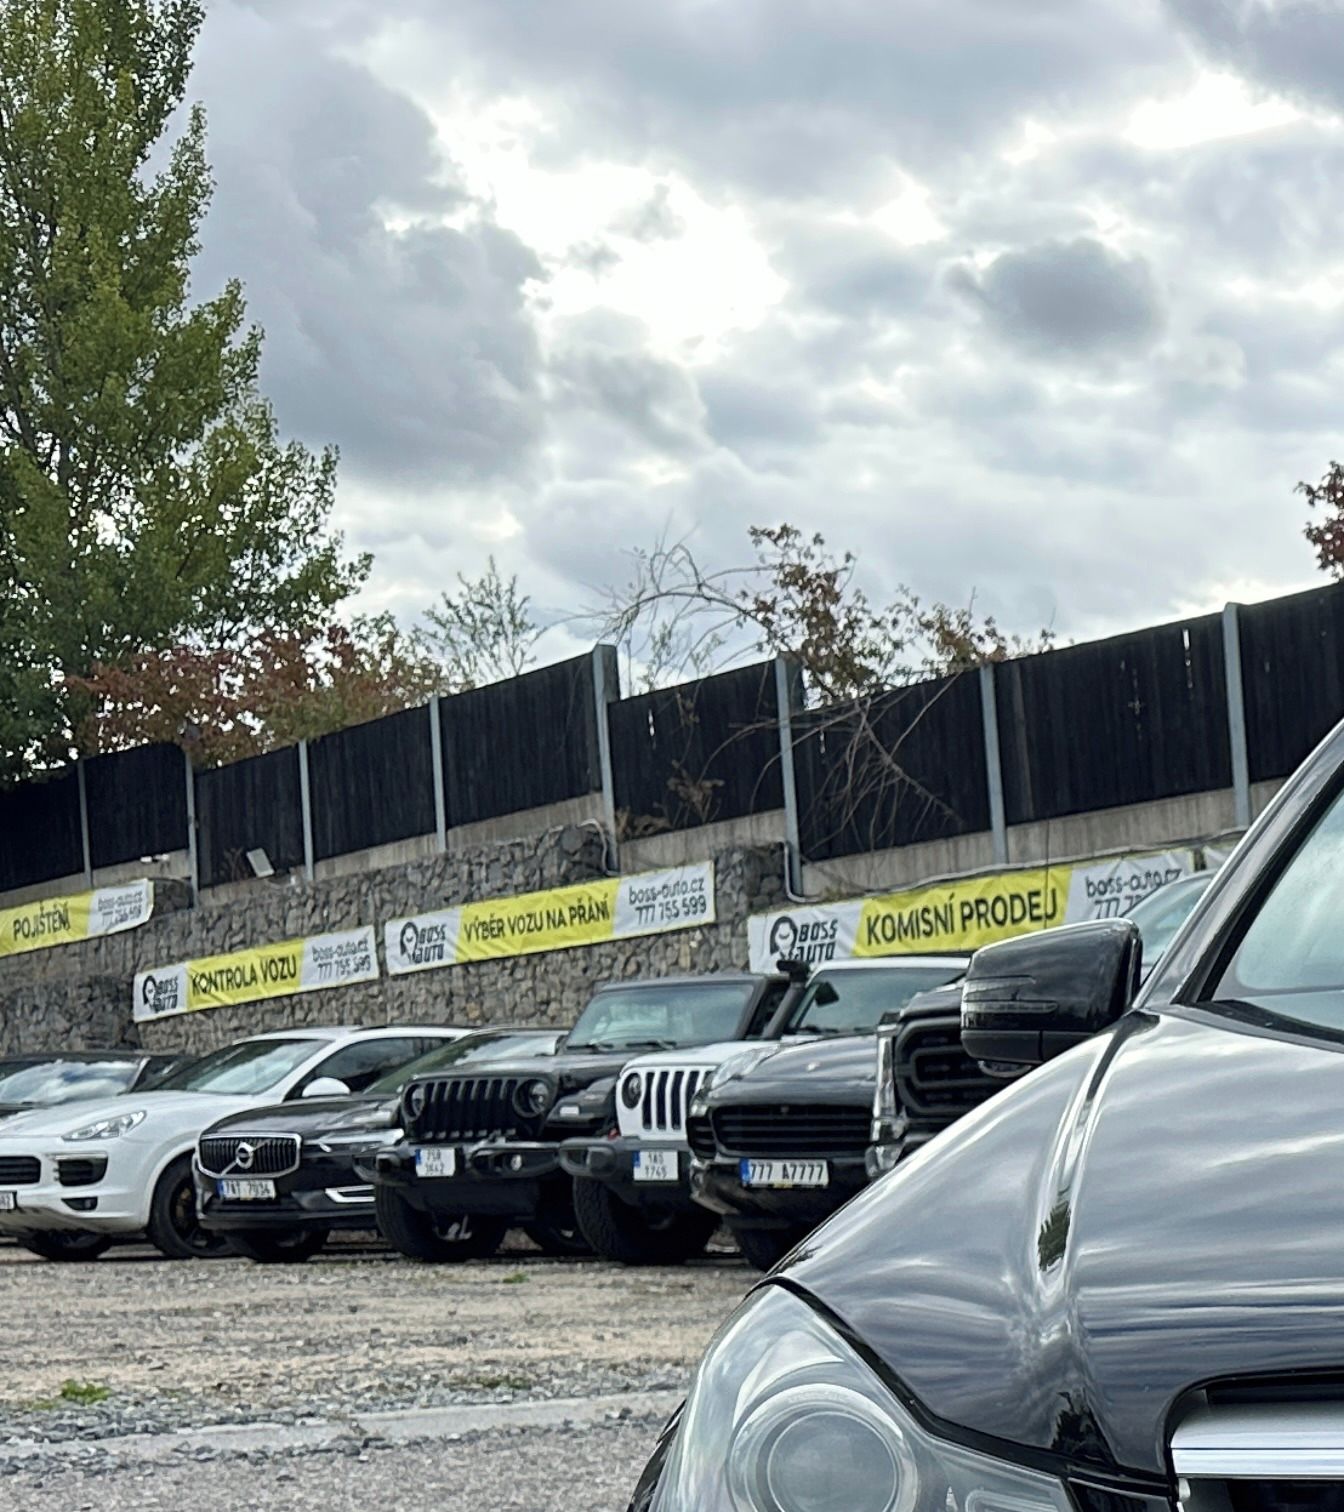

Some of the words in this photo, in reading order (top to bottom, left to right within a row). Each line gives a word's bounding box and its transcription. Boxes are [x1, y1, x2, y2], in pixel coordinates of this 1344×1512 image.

[627, 879, 705, 905] boss-auto.cz
[1085, 868, 1183, 898] boss-autocz
[464, 913, 506, 942] VÝBĚR
[507, 905, 543, 936] VOZU
[546, 904, 566, 930] NA
[568, 897, 610, 925] PŘÁNÍ
[866, 893, 955, 946] KOMISNÍ
[961, 887, 1057, 934] PRODEJ
[800, 920, 838, 942] BOSS
[796, 942, 836, 963] AUTO
[191, 962, 257, 996] KONTROLA
[260, 954, 297, 983] VOZU
[751, 1163, 773, 1180] 777
[782, 1163, 824, 1180] A7777
